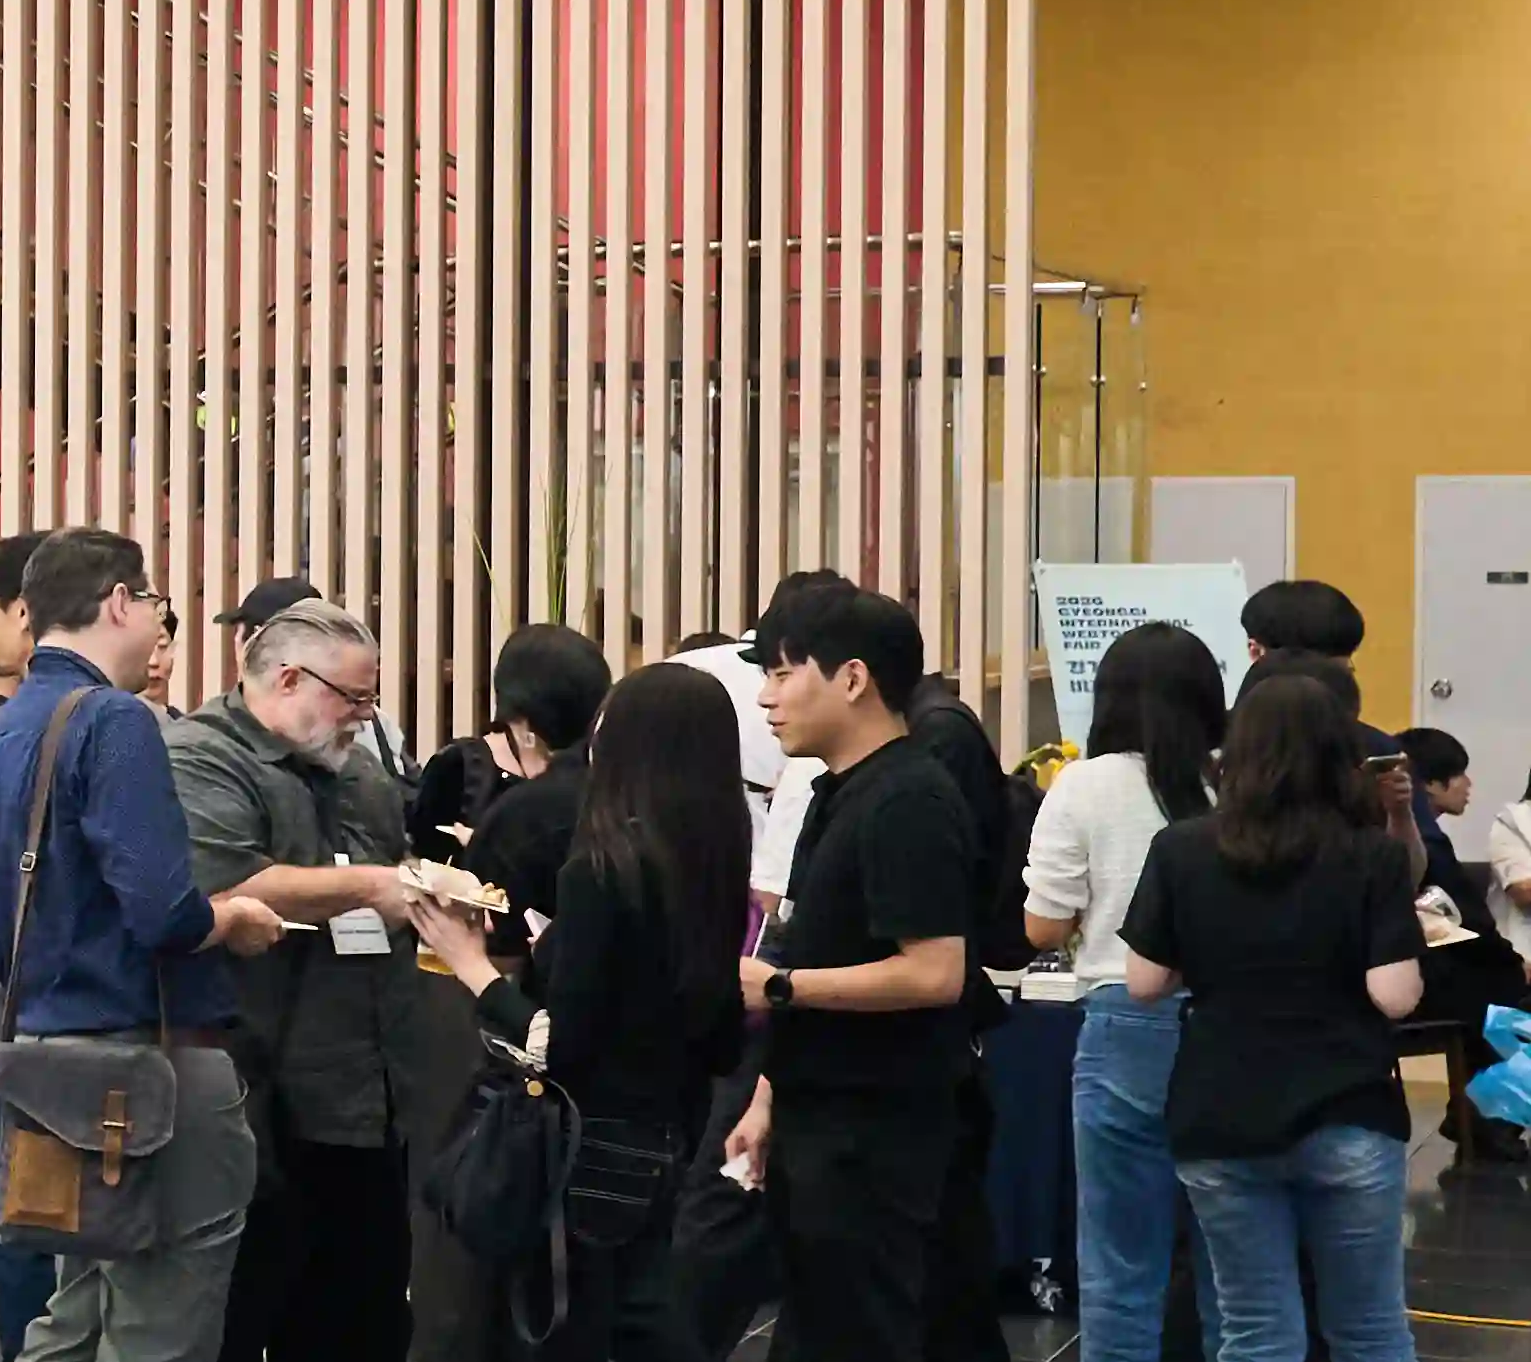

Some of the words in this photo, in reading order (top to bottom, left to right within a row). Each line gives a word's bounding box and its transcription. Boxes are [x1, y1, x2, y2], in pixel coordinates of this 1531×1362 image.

[1056, 596, 1103, 606] 2026
[1058, 607, 1147, 617] GYEONGGI
[1059, 618, 1194, 628] INTERNATINAL
[1061, 630, 1124, 639] WEBTO
[1063, 641, 1102, 650] FAIR
